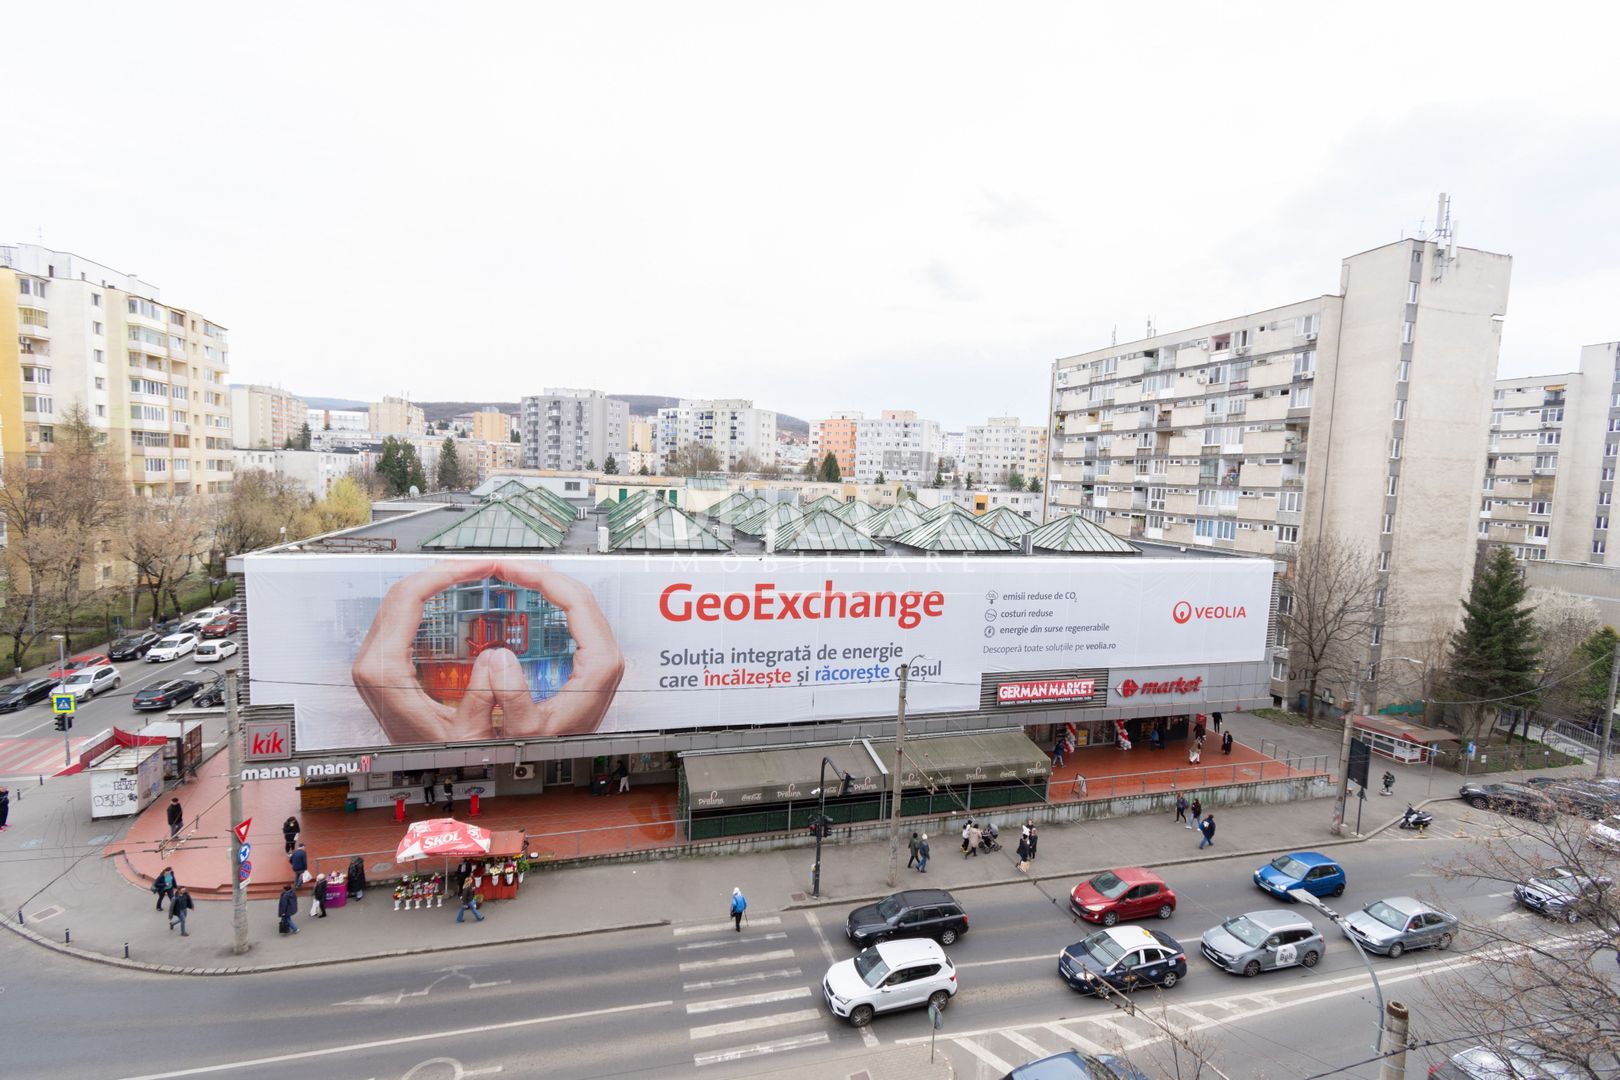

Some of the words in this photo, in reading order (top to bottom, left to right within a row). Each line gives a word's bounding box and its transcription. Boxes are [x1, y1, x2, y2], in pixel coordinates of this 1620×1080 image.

[659, 580, 945, 629] GeoExchange
[1003, 592, 1026, 601] emisii
[1027, 592, 1052, 600] reduse
[1054, 592, 1064, 600] de
[1000, 609, 1027, 618] costuri
[1028, 609, 1054, 618] reduse
[1195, 605, 1247, 620] VEOLIA
[1000, 625, 1029, 636] energie
[1030, 624, 1043, 634] din
[1065, 623, 1110, 635] regenerabile
[659, 648, 725, 670] Soluția
[731, 645, 811, 668] integrată
[817, 644, 838, 660] de
[842, 642, 903, 663] energie
[1024, 644, 1044, 653] toate
[1074, 644, 1085, 652] pe
[1086, 642, 1117, 651] veolia.ro
[659, 674, 699, 688] care
[703, 668, 792, 688] încălzește
[797, 666, 809, 686] și
[815, 663, 890, 684] răcorește
[999, 683, 1048, 699] GERMAN
[1048, 680, 1095, 696] MARKET
[1141, 675, 1203, 695] market
[252, 729, 285, 755] kik
[241, 766, 301, 781] mama
[422, 832, 462, 849] SKOL
